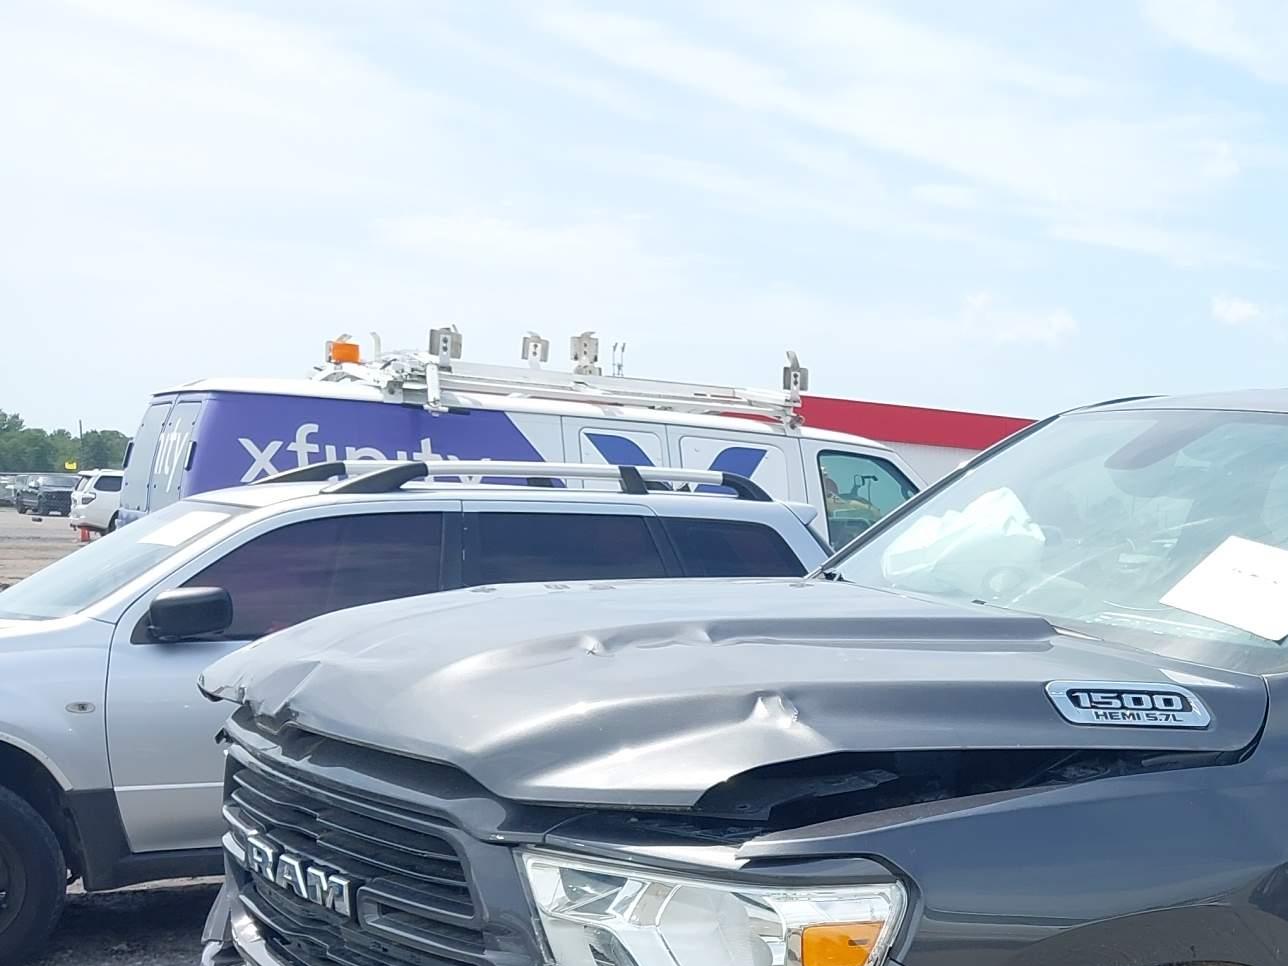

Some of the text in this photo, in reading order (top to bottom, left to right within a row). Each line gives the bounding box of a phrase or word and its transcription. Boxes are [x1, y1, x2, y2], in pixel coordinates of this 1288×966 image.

[237, 423, 493, 486] xfint
[1072, 691, 1183, 711] 1500
[1095, 711, 1183, 722] HEMI 5.7L
[247, 835, 352, 917] RAM
